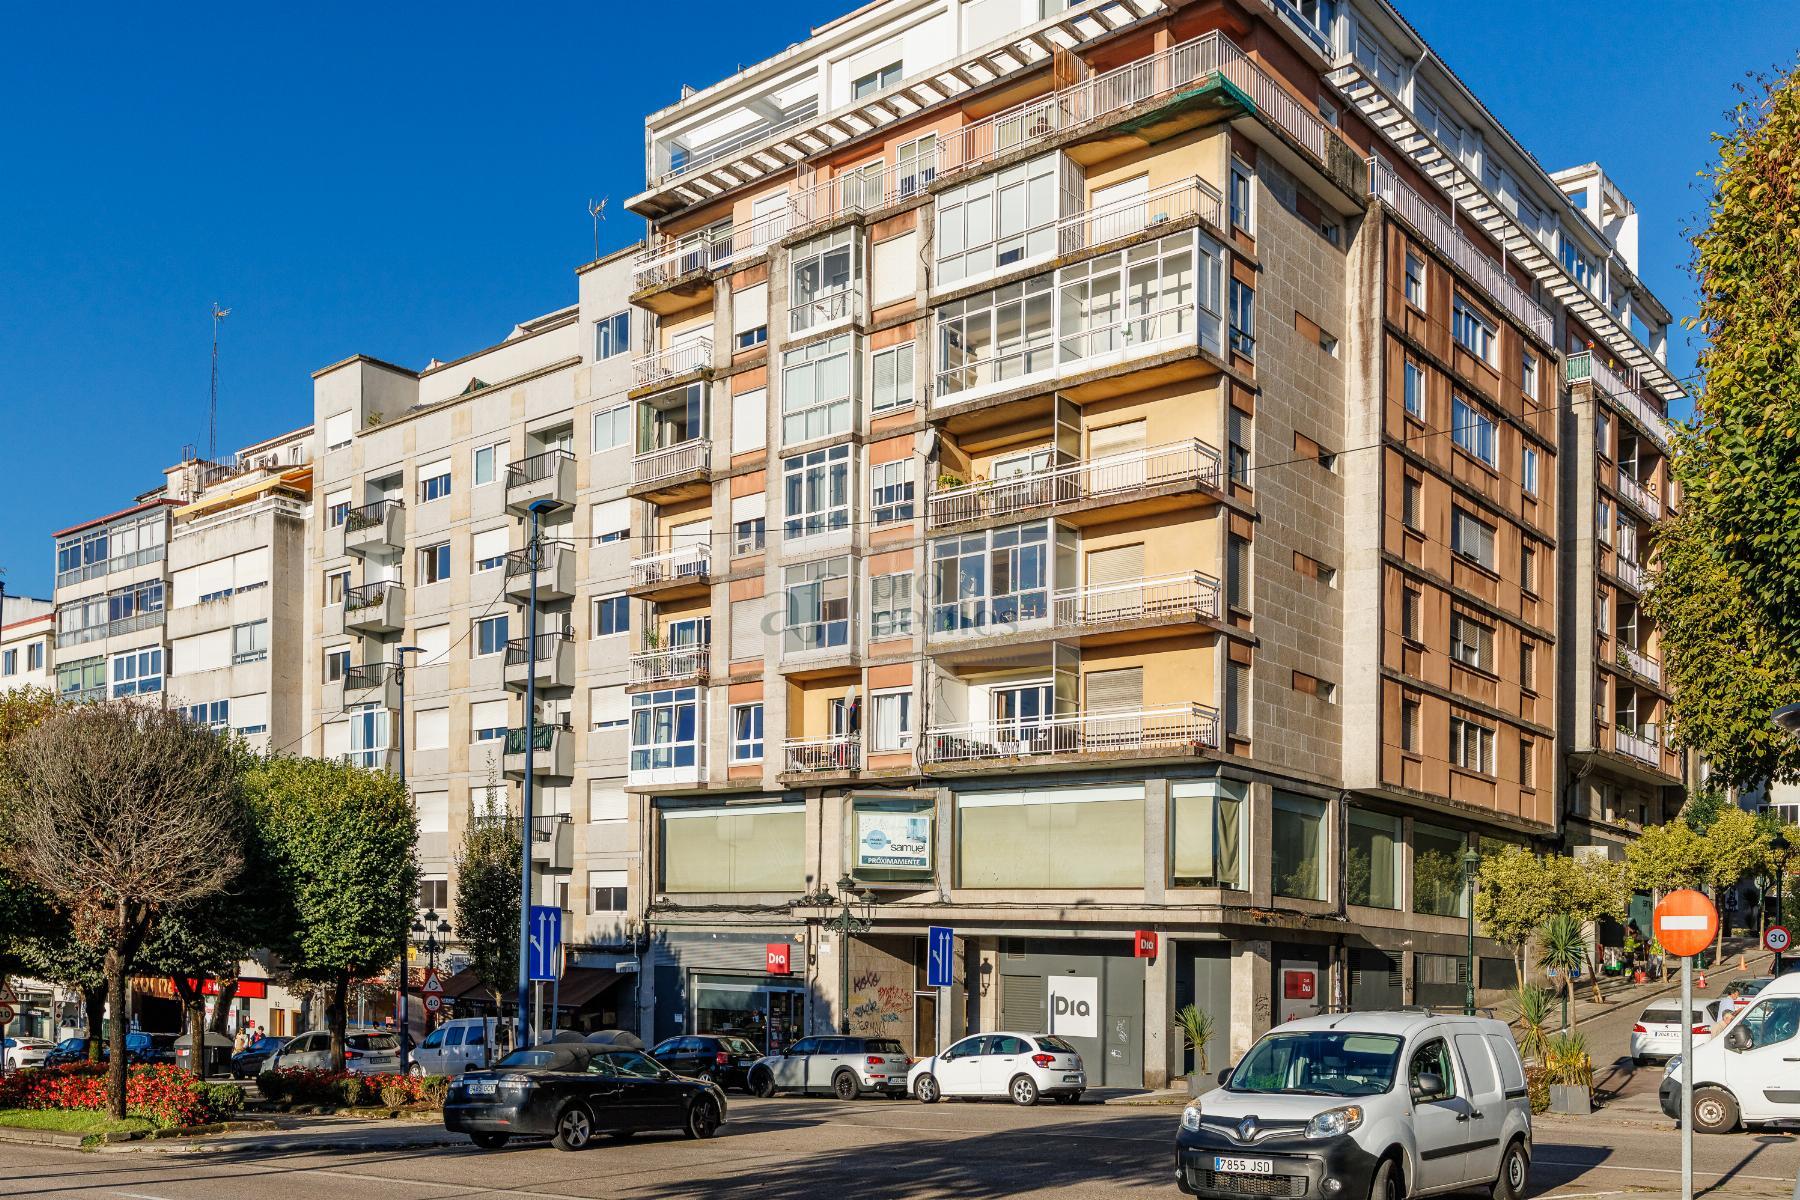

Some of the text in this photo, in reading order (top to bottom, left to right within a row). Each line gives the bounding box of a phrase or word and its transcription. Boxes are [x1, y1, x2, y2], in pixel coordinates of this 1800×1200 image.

[890, 843, 926, 852] samuel
[867, 856, 921, 866] PRÓXIMAMENTE
[1770, 933, 1786, 943] 30
[427, 999, 439, 1007] 40
[1220, 1159, 1270, 1173] 7855 JSD
